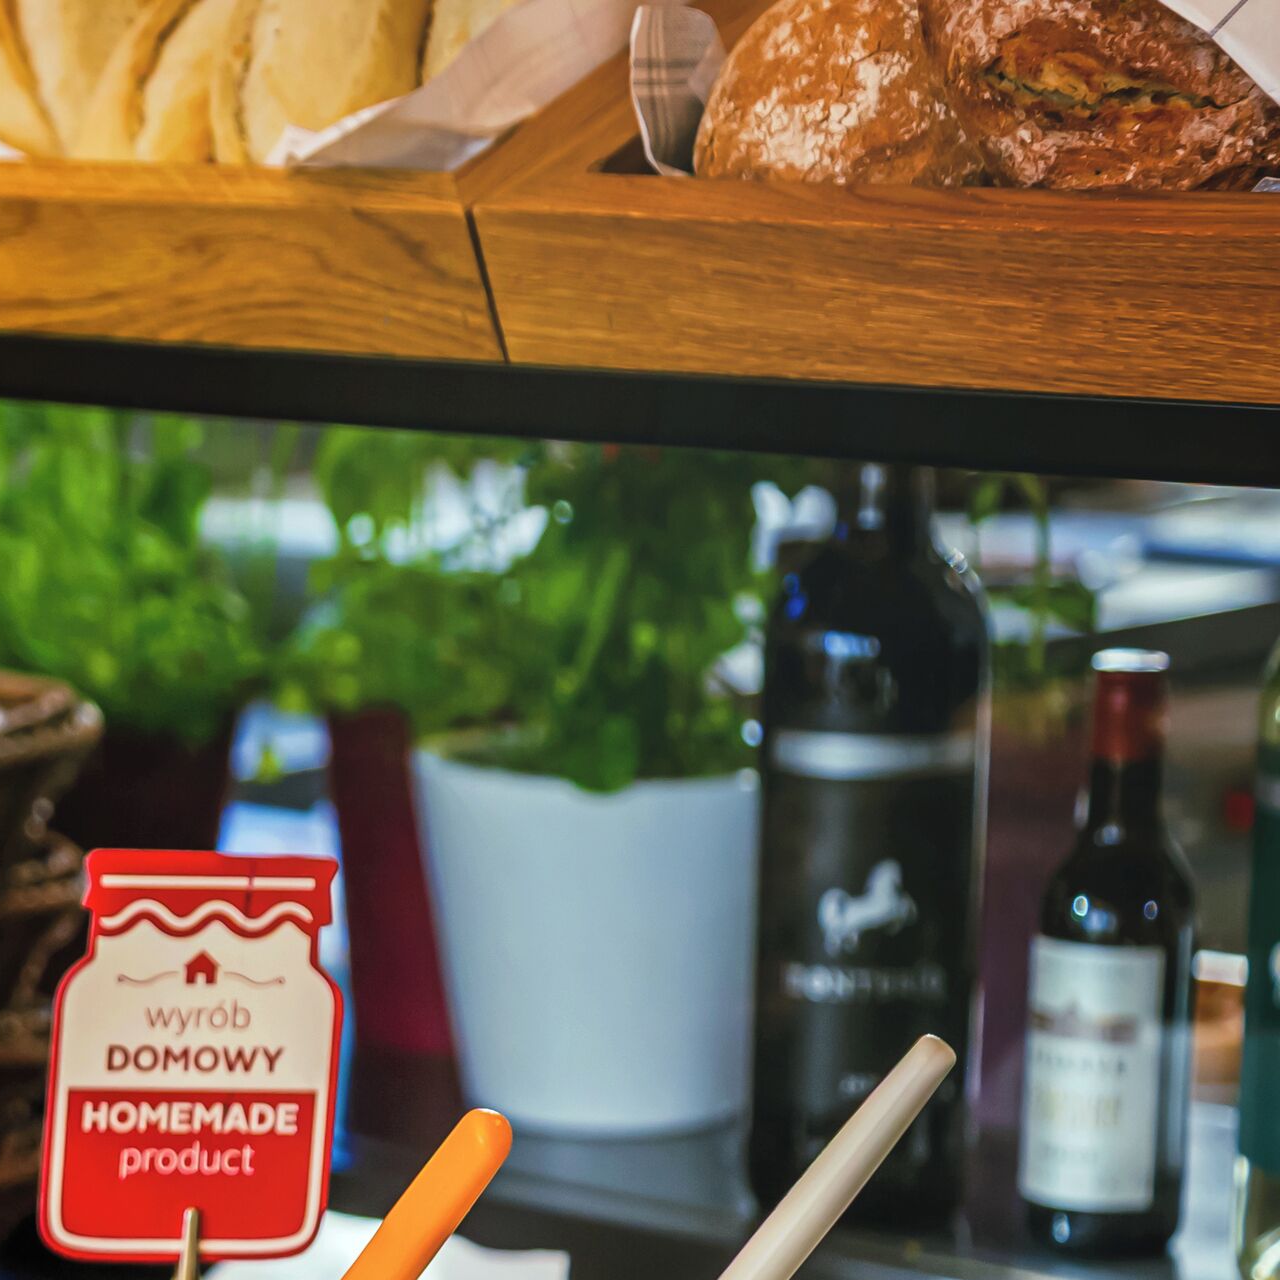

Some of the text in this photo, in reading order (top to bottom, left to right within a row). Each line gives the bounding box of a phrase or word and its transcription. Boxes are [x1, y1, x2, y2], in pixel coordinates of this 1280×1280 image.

[144, 1000, 251, 1036] wyrób
[106, 1044, 283, 1075] DOMOWY
[81, 1100, 300, 1135] HOMEMADE
[118, 1141, 256, 1180] product
